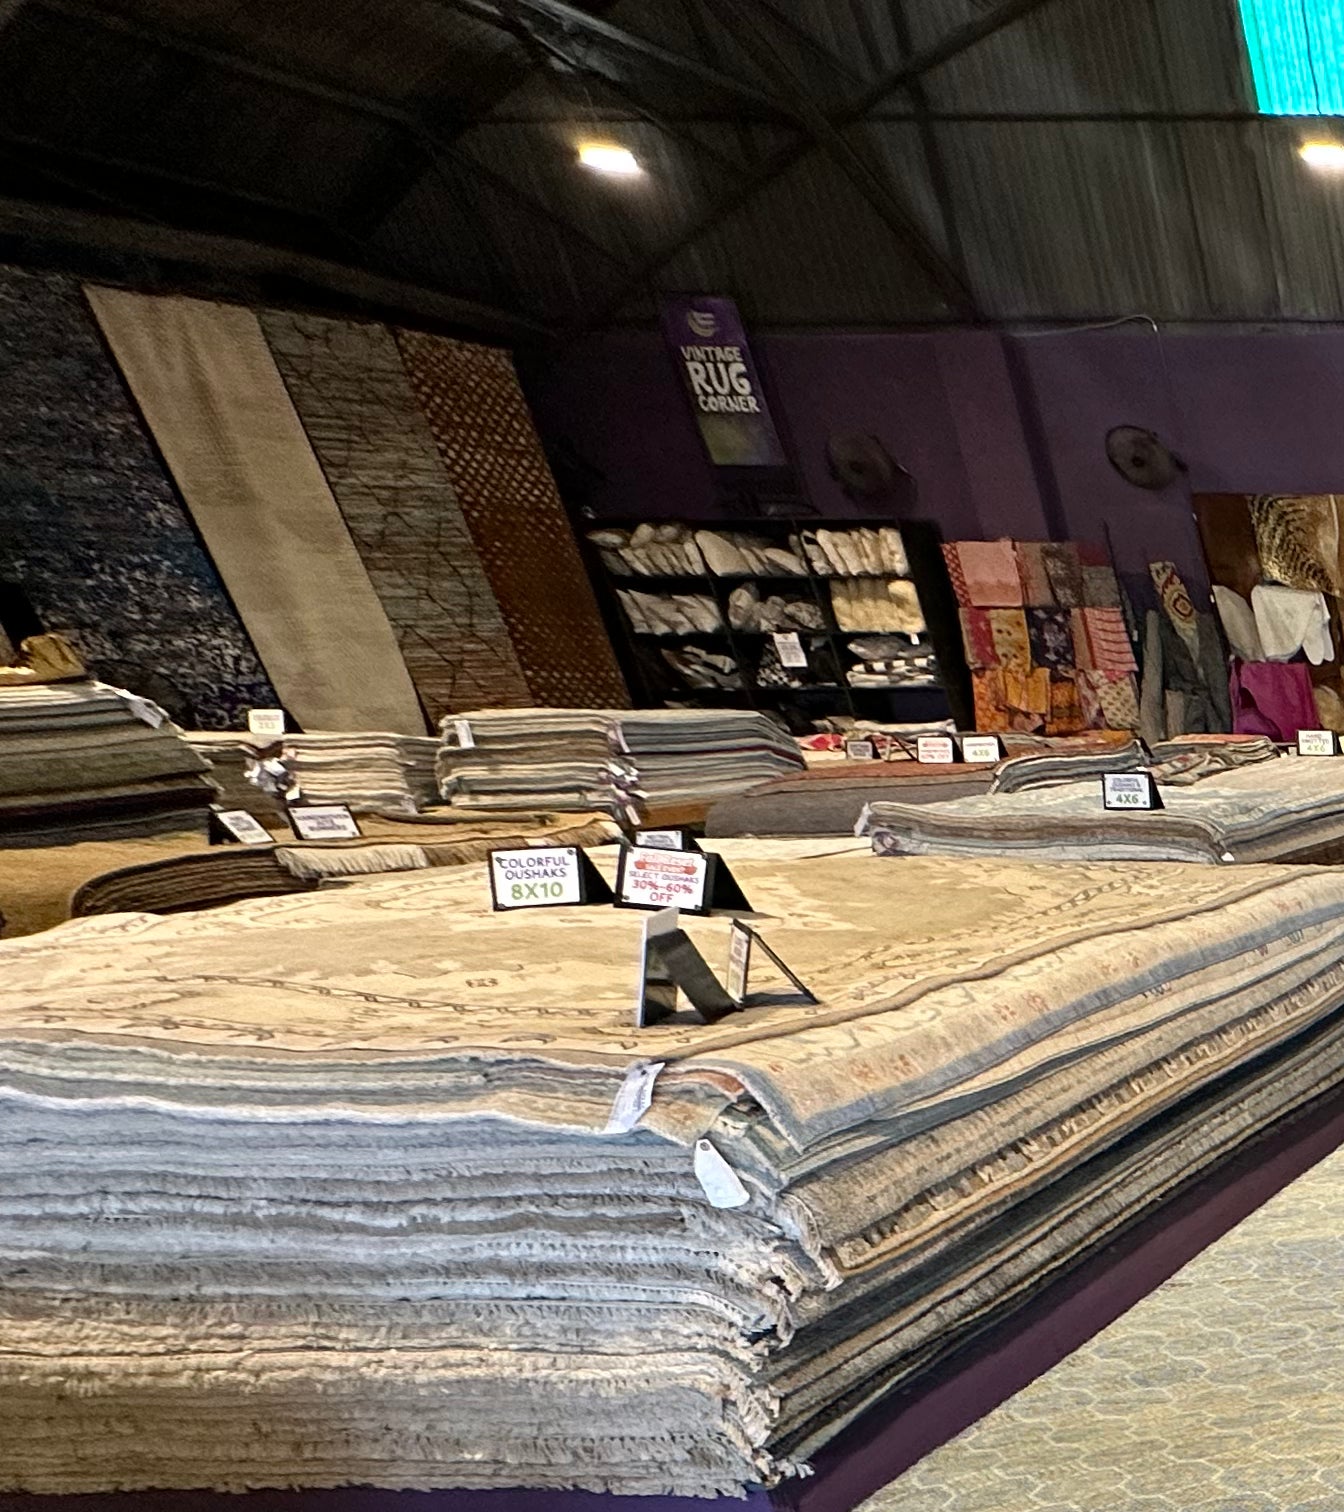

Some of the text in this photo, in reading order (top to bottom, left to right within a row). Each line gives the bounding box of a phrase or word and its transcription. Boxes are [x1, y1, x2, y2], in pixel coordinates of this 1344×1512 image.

[681, 346, 743, 361] VINTAGE
[686, 361, 752, 395] RUG
[698, 395, 760, 412] CORNER
[1116, 793, 1139, 804] 4X6
[500, 856, 570, 869] COLORFUL
[505, 867, 567, 880] OUSHAKS
[629, 870, 699, 884] SELECT OUSHAKS
[511, 882, 563, 900] 8X10
[650, 892, 673, 903] OFF
